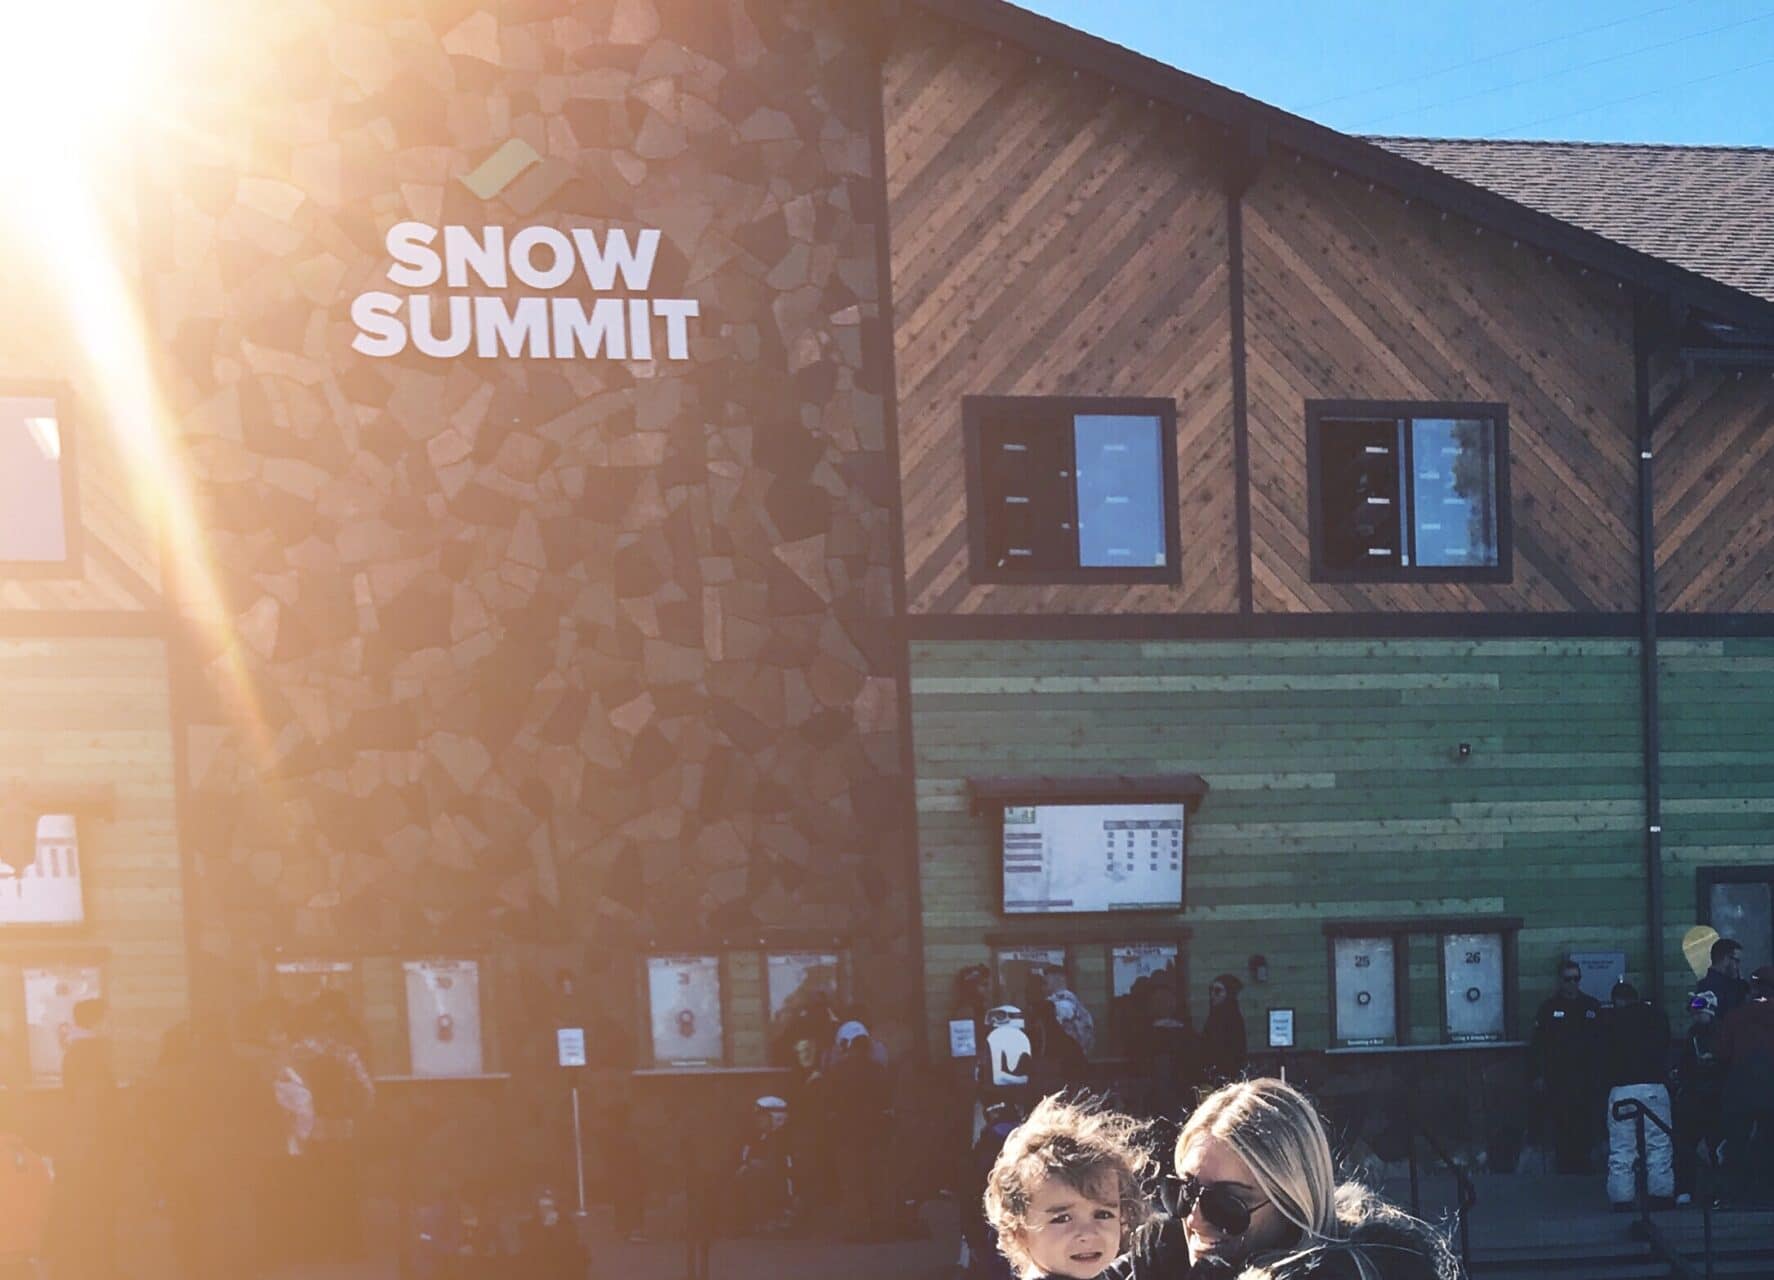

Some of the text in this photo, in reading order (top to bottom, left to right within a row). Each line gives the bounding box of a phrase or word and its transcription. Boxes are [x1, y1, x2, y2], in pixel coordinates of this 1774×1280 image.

[385, 222, 662, 291] SNOW
[350, 291, 699, 360] SUMMIT
[1355, 955, 1370, 968] 25
[1465, 951, 1481, 964] 26
